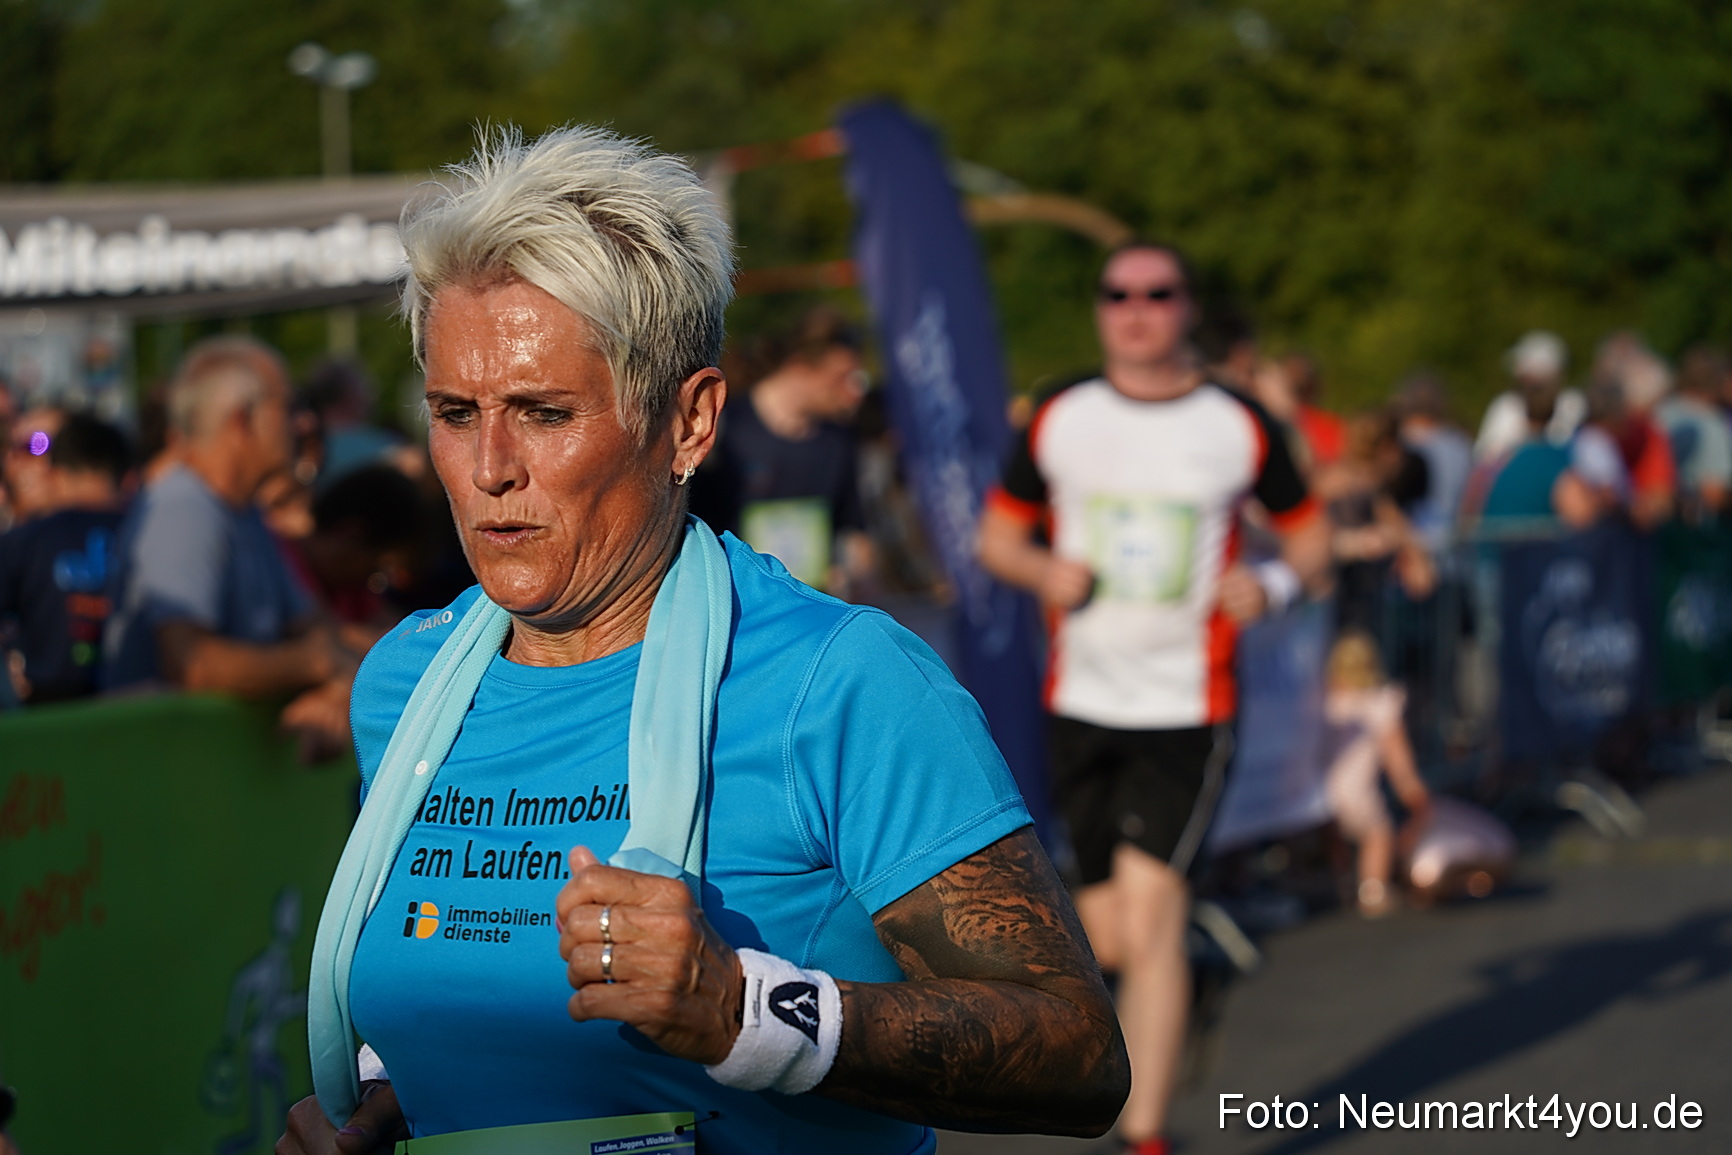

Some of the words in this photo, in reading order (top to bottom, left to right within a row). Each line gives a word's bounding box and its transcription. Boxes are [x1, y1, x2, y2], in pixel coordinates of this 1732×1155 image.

[415, 610, 453, 633] JAKO
[410, 847, 453, 878] am
[462, 839, 569, 880] Laufen.
[447, 904, 552, 927] immobilien
[443, 922, 511, 944] dienste
[594, 1143, 619, 1153] Laufen,
[646, 1135, 675, 1147] Walken
